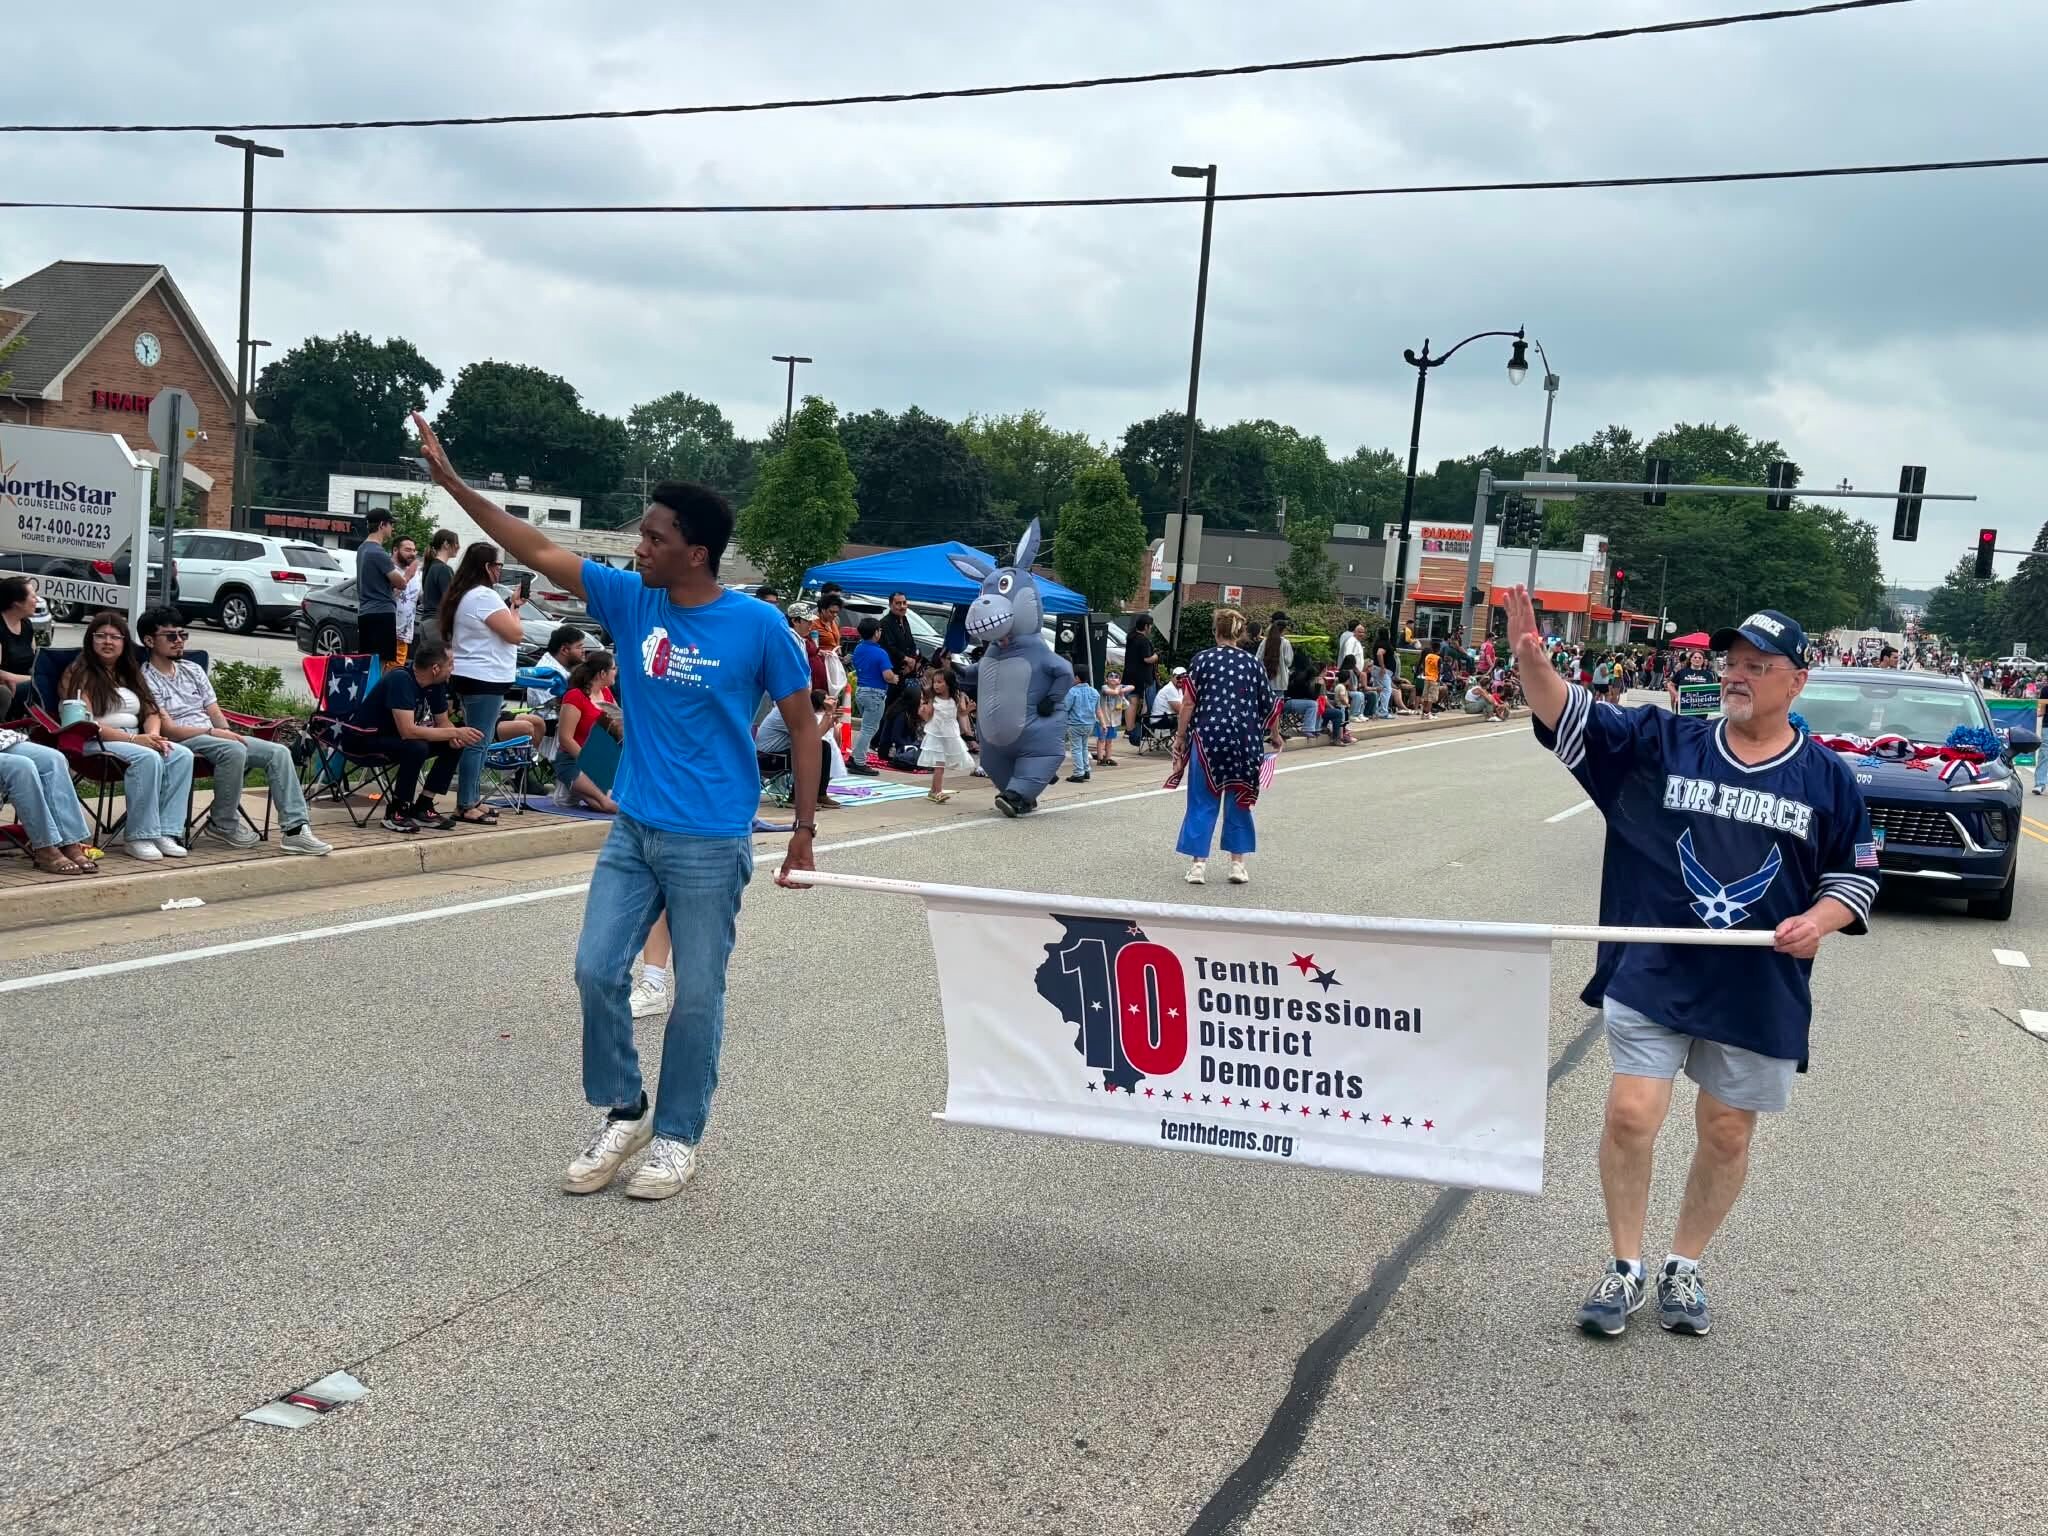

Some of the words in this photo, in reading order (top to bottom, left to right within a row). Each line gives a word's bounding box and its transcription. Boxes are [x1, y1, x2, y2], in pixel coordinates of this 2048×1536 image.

[17, 497, 76, 512] COUNSELING
[80, 504, 112, 516] GROUP
[18, 514, 111, 541] 847-400-0223
[21, 533, 44, 542] HOURS
[46, 535, 56, 544] BY
[57, 537, 106, 550] APPOINTMENT
[44, 579, 118, 605] PARKING
[1663, 775, 1716, 814] AIR
[1714, 783, 1814, 840] FORCE
[1194, 956, 1279, 986] Tenth
[1060, 938, 1188, 1075] 10
[1197, 987, 1422, 1033] Congressional
[1199, 1020, 1312, 1057] District
[1200, 1054, 1363, 1099] Democrats
[1160, 1118, 1293, 1157] tenthdems.org
